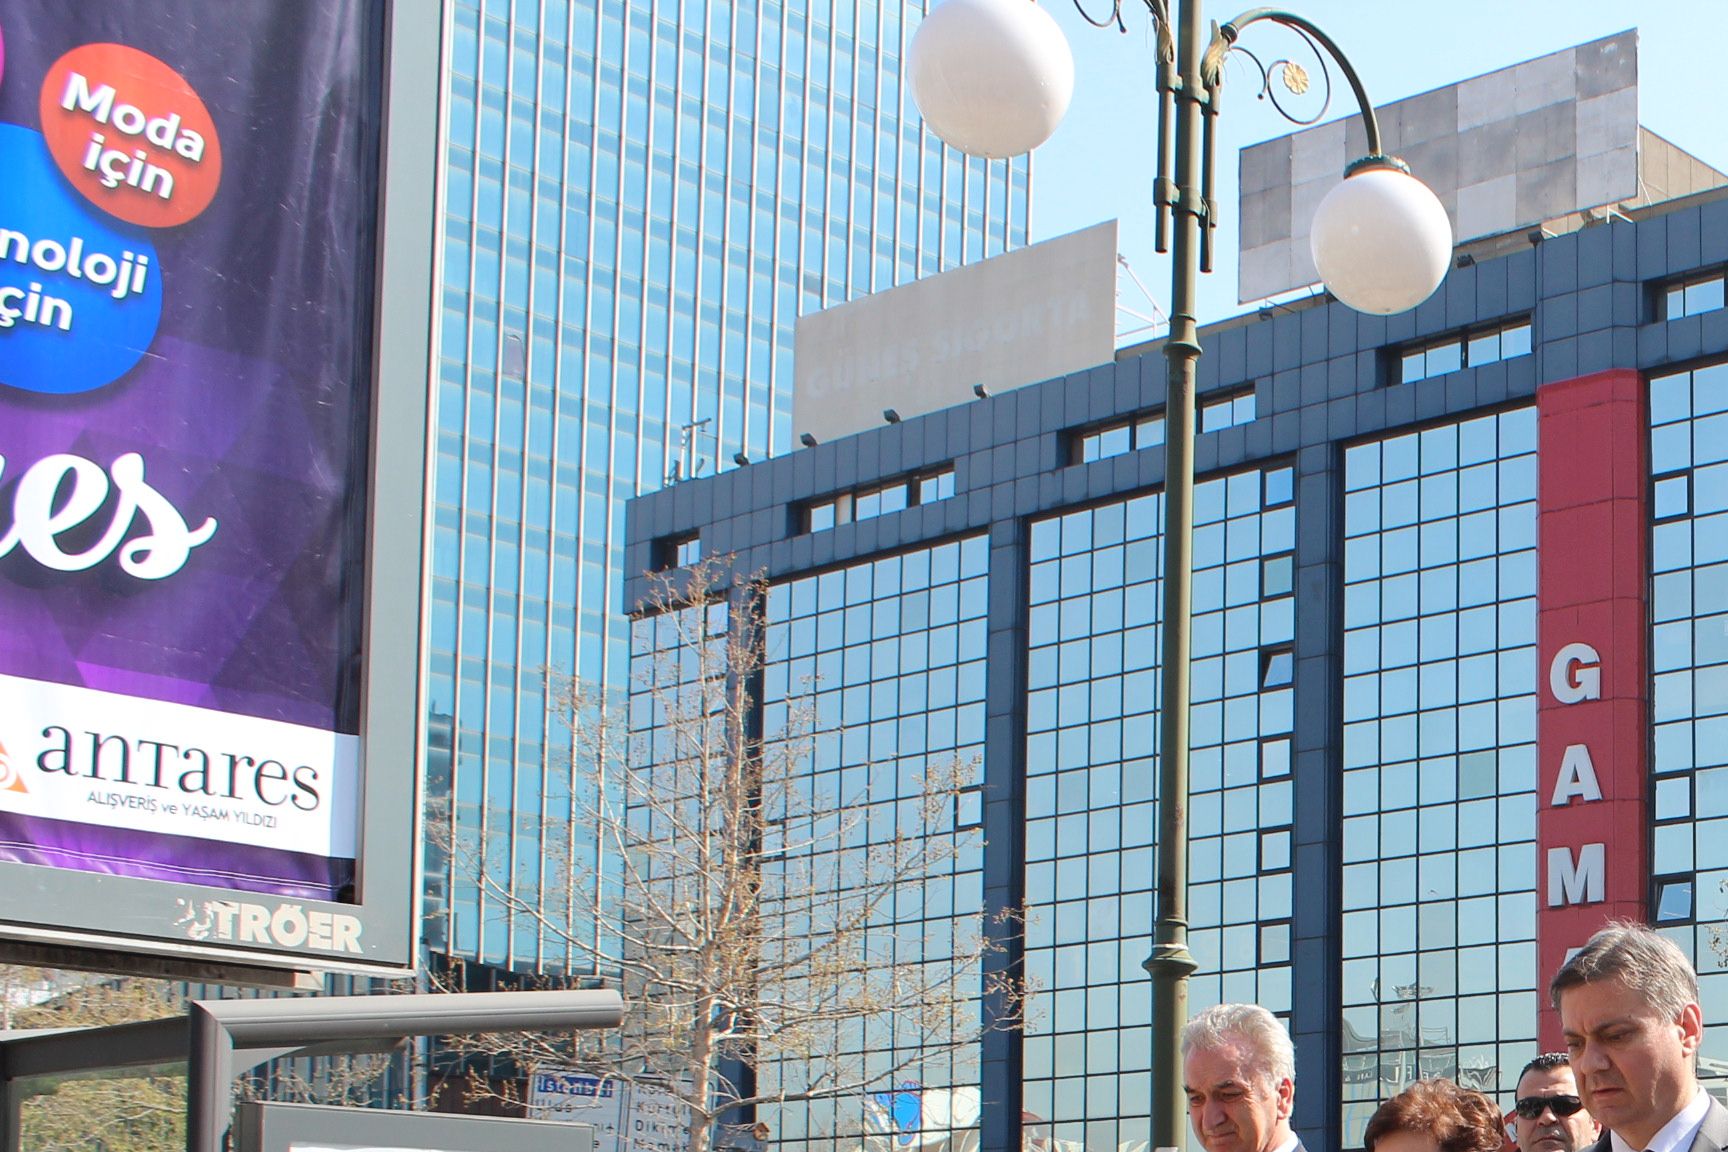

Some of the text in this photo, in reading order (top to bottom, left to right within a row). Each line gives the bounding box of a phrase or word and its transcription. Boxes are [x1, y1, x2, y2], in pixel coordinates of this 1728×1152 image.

[61, 71, 205, 162] Moda
[82, 134, 174, 200] için
[87, 791, 278, 829] ALIŞVERİŞ ve YAŞAM YILDIZI
[634, 1119, 690, 1136] Dikme
